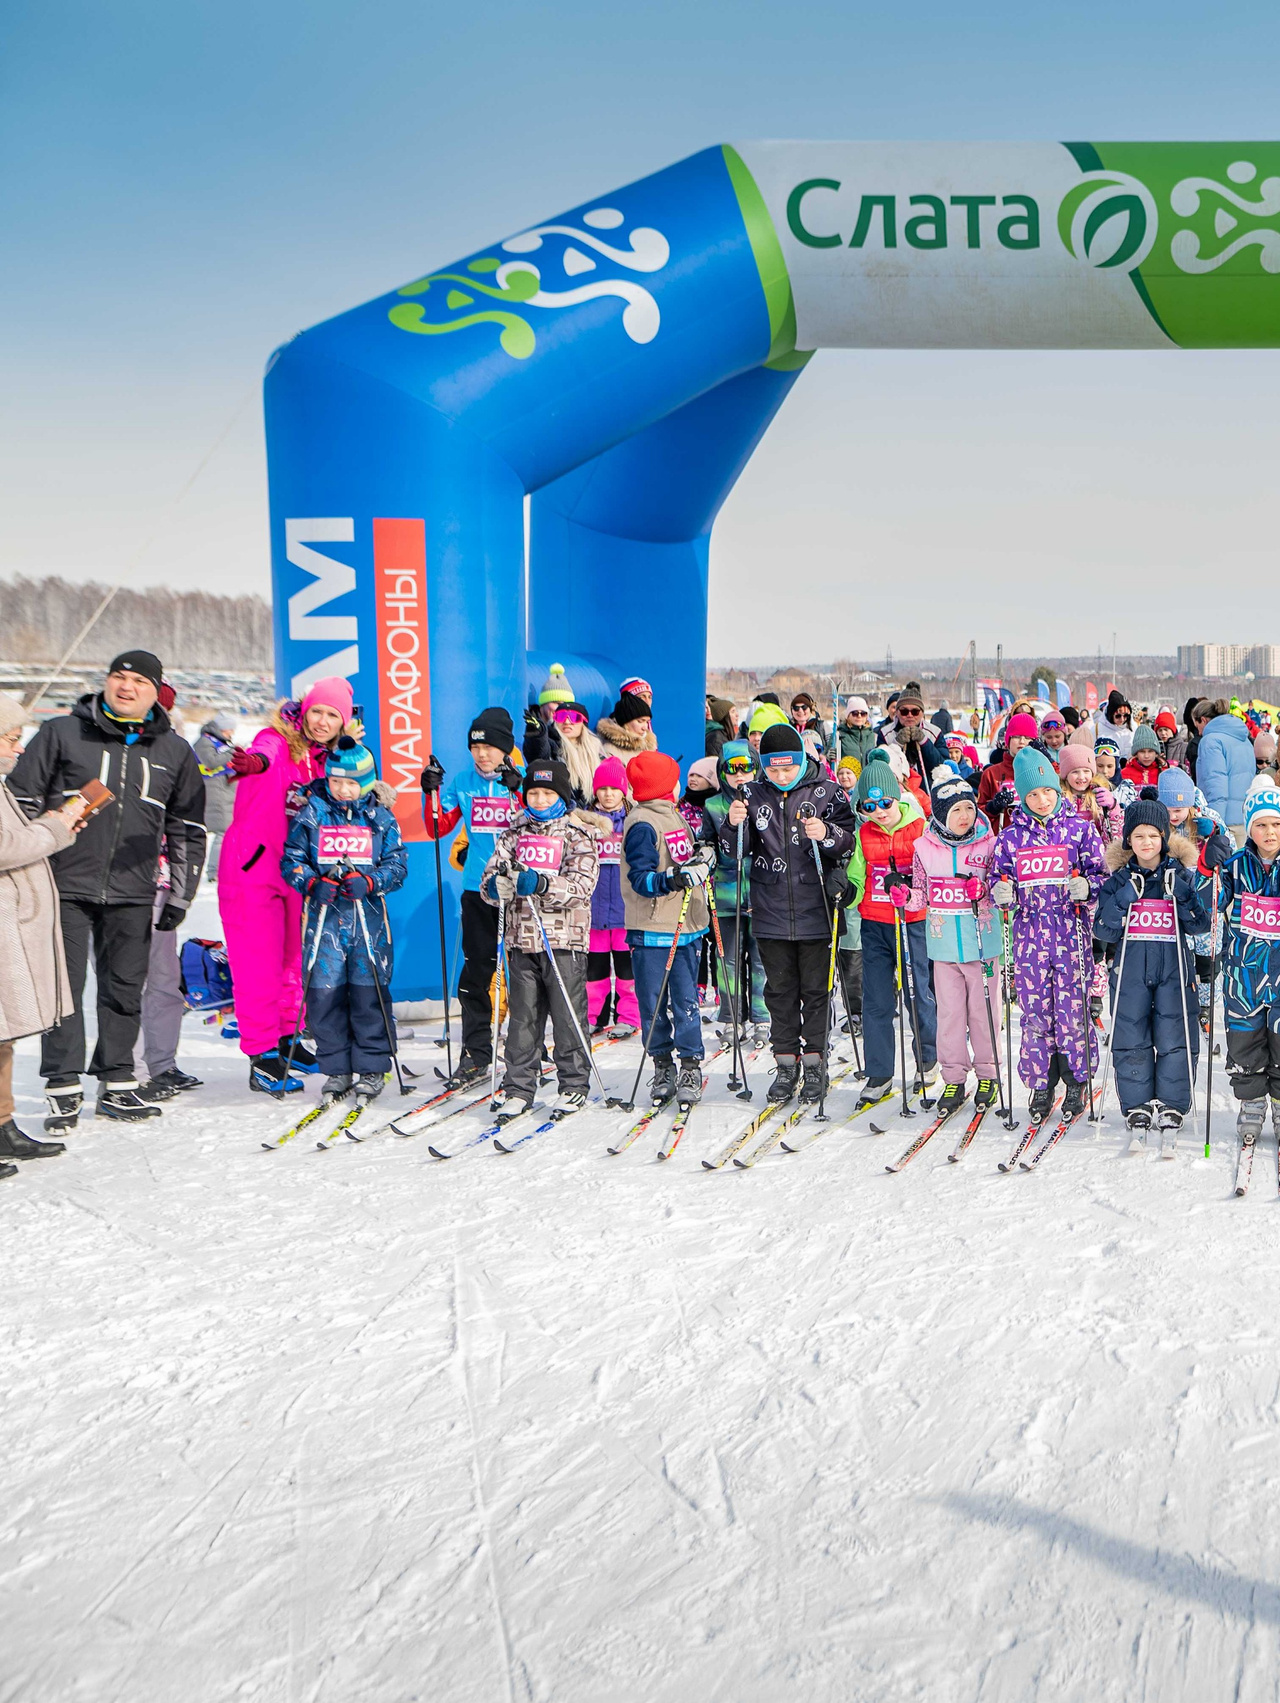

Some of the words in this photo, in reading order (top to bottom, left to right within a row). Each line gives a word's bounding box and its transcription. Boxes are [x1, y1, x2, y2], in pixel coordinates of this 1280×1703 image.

[786, 178, 1041, 250] Слата
[383, 568, 422, 793] МАРАФОНЫ
[323, 836, 368, 853] 2027
[518, 846, 555, 864] 2031
[1020, 856, 1065, 875] 2072
[1129, 911, 1173, 928] 2035
[1008, 1131, 1031, 1165] MADSHUS
